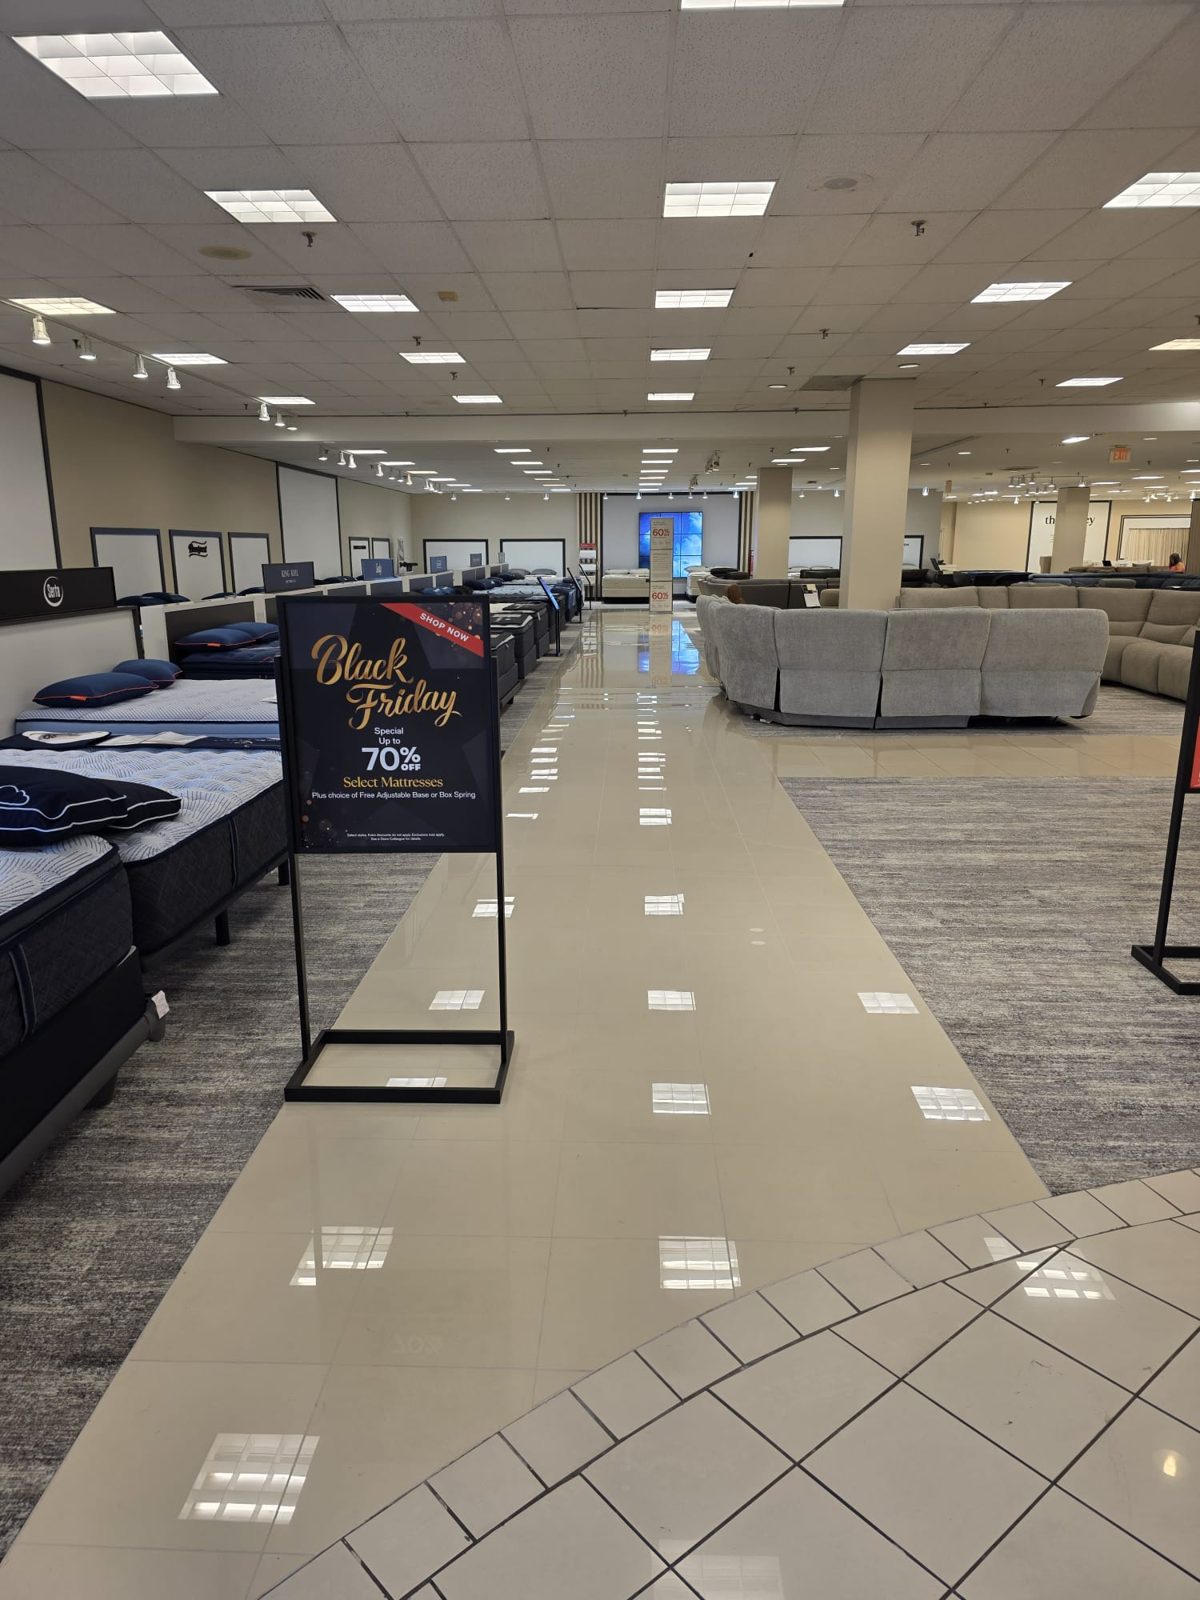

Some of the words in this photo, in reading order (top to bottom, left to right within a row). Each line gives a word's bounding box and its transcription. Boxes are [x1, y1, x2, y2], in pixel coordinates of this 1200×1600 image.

[419, 612, 446, 629] SHOP
[446, 626, 470, 642] NOW
[311, 634, 414, 685] Black
[346, 679, 463, 730] Friday
[374, 727, 404, 736] Special
[378, 737, 391, 746] Up
[361, 747, 421, 771] 70%
[400, 763, 421, 771] OFF
[343, 776, 378, 788] Select
[381, 776, 444, 788] Mattresses
[311, 791, 327, 799] Plus
[328, 791, 350, 799] choice
[351, 791, 358, 799] of
[359, 791, 375, 799] Free
[376, 791, 411, 800] Adjustable
[412, 791, 430, 799] Base
[439, 791, 452, 799] Box
[453, 791, 476, 800] Spring
